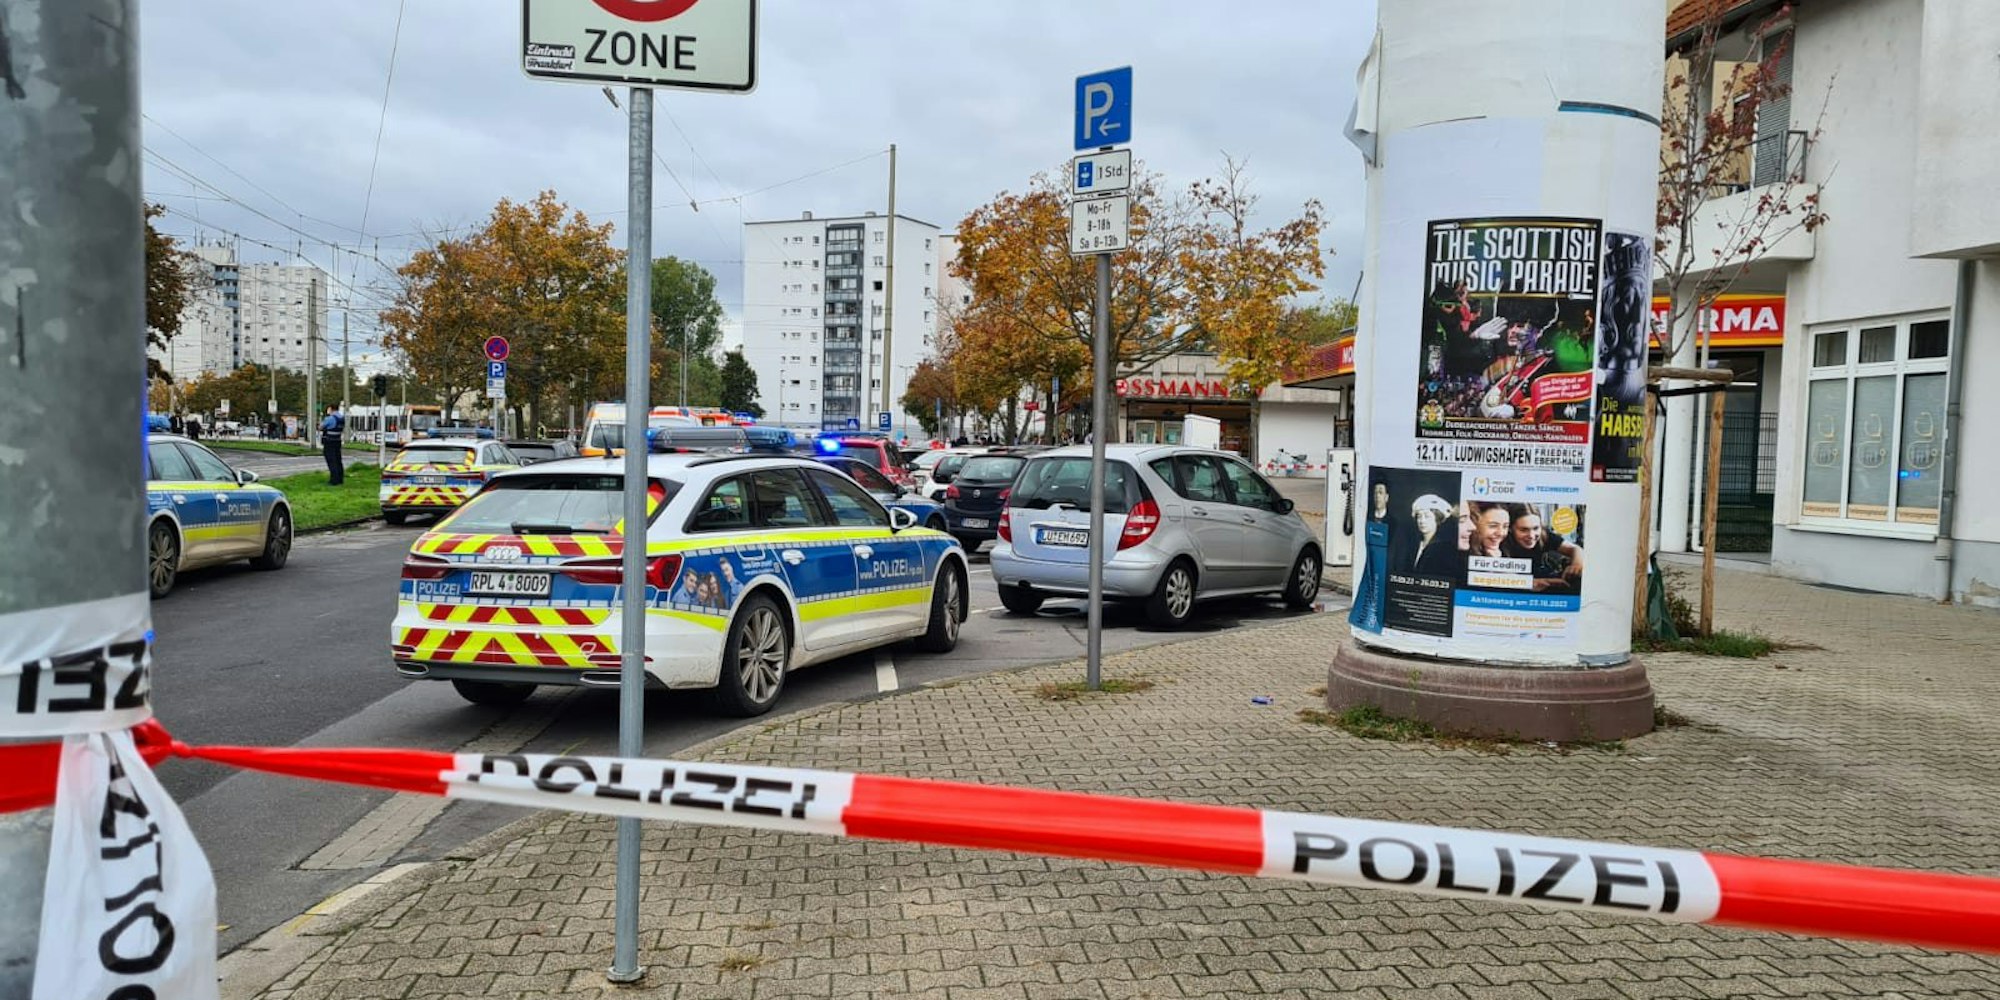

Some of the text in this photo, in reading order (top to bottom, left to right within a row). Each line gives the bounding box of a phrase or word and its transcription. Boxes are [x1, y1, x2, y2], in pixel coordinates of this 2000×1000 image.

[526, 44, 575, 57] Eintracht
[584, 28, 697, 71] ZONE
[526, 58, 573, 71] Frankfurt
[1084, 81, 1114, 140] P
[1098, 166, 1103, 179] 1
[1086, 202, 1112, 215] Mo-Fr
[1079, 238, 1090, 250] Sa
[1433, 227, 1596, 261] THE SCOTTISH
[1428, 259, 1595, 298] MUSIC PARADE
[1649, 306, 1779, 333] NRMA
[1116, 378, 1229, 398] OSSMANN
[1601, 396, 1618, 412] Die
[1416, 444, 1448, 461] 12.11.
[1454, 446, 1532, 465] LUDWIGSHAFEN
[1534, 457, 1585, 466] EBERT-HALLE
[1492, 486, 1515, 494] CODE
[1474, 559, 1527, 571] Für Coding
[418, 581, 461, 596] POLIZEI
[472, 573, 548, 592] RPL 4 8009
[466, 753, 818, 820] POLIZEI
[1291, 830, 1682, 915] POLIZEI
